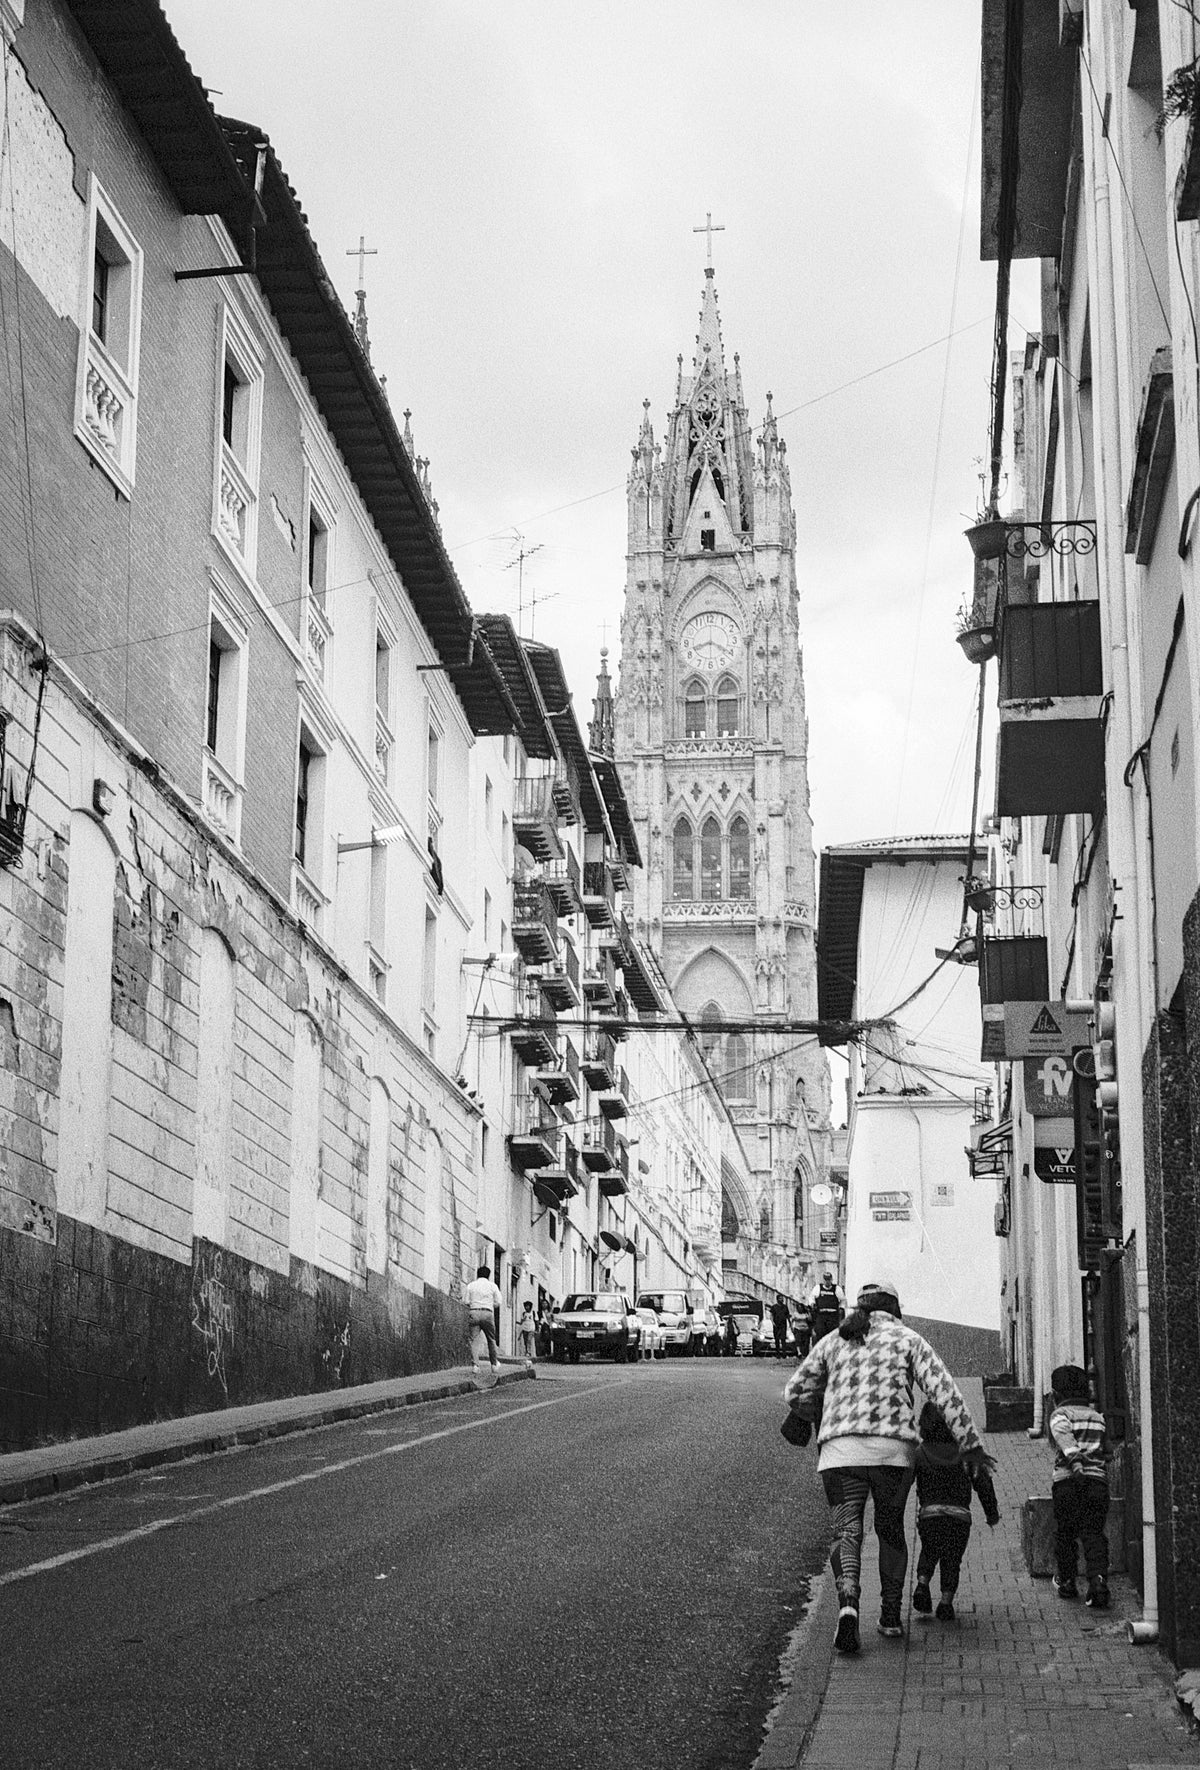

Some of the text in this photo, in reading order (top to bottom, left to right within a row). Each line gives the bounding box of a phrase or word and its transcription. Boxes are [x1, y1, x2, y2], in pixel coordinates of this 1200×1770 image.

[695, 618, 702, 627] 11
[706, 615, 714, 623] 12
[729, 624, 734, 633] 2
[683, 639, 689, 648] 9
[732, 636, 737, 645] 3
[687, 651, 692, 659] 8
[697, 659, 702, 667] 7
[708, 661, 713, 669] 6
[719, 658, 725, 666] 5
